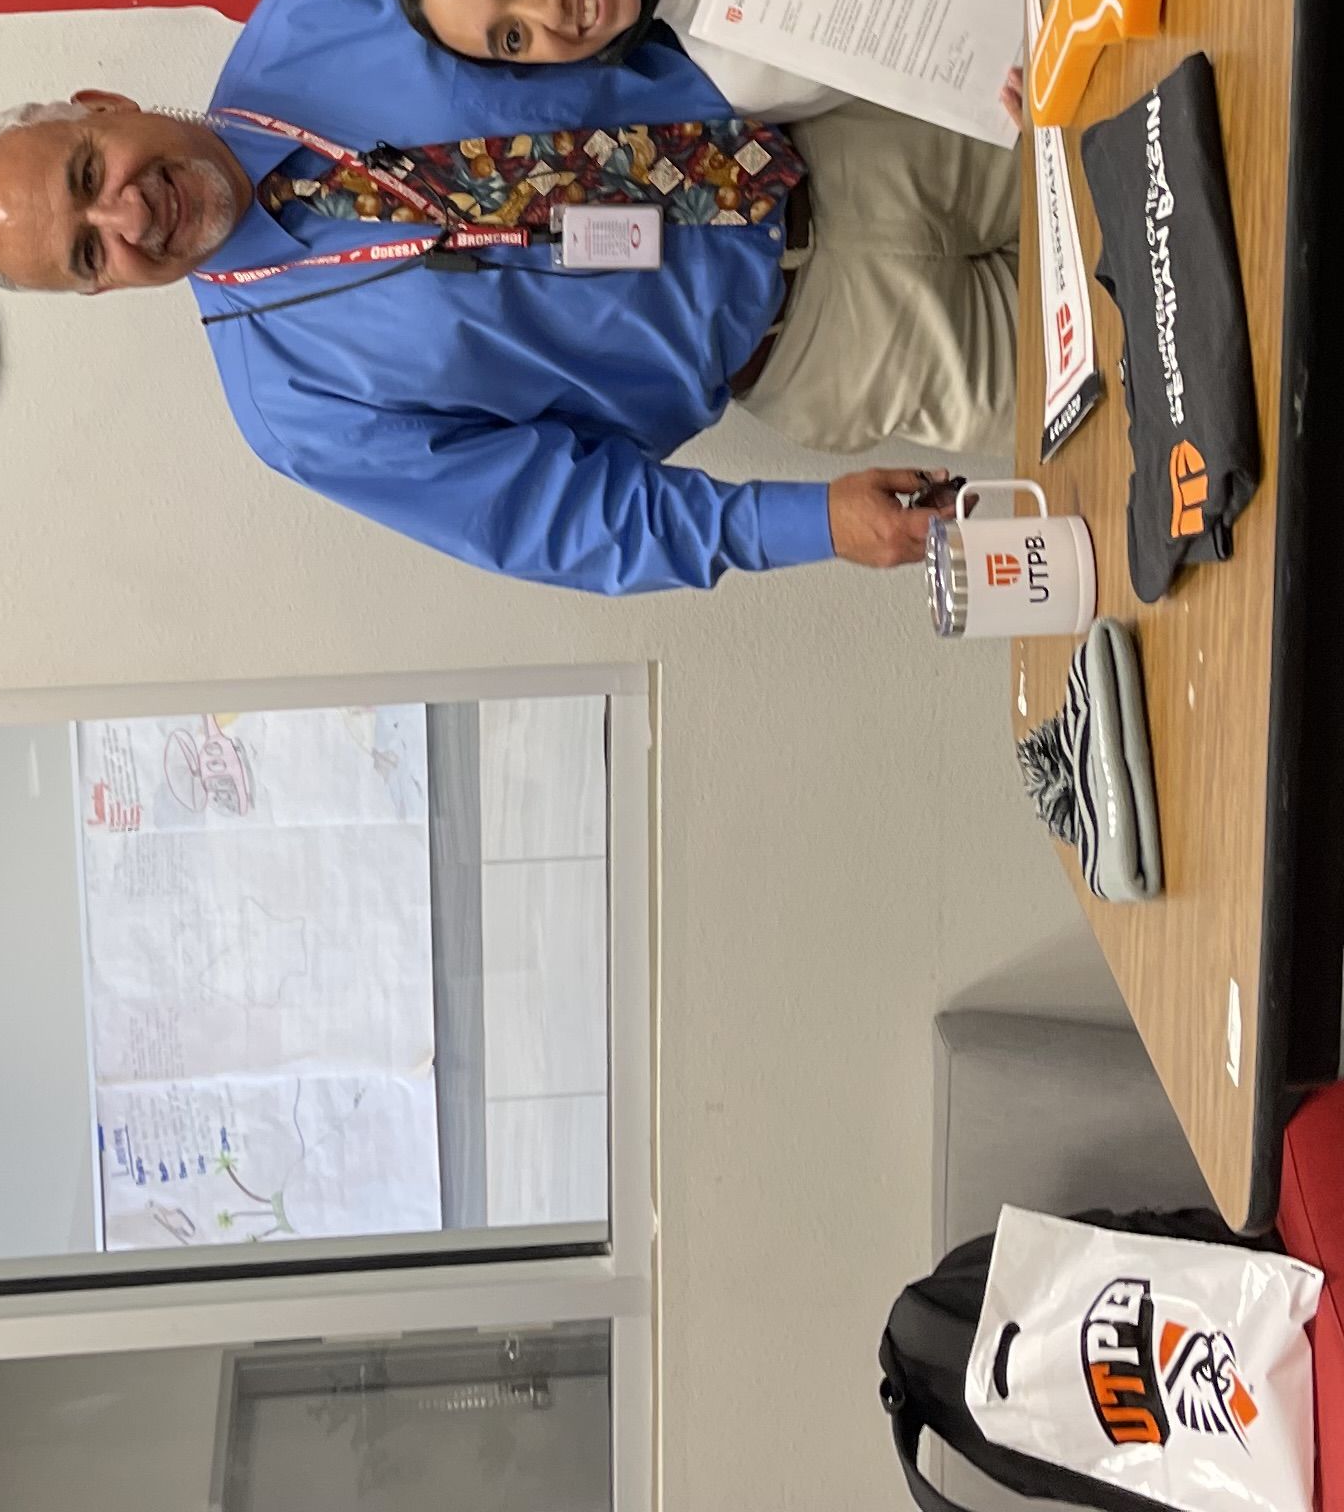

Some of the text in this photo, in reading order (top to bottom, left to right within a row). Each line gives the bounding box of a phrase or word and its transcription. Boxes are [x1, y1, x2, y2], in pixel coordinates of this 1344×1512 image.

[370, 241, 420, 259] ODESSA
[1145, 216, 1156, 246] OF
[1146, 95, 1185, 425] PERMIAN BASIN
[1150, 249, 1172, 380] UNIVERSITY
[1025, 536, 1049, 604] UTPB
[1086, 1280, 1164, 1445] UTPB
